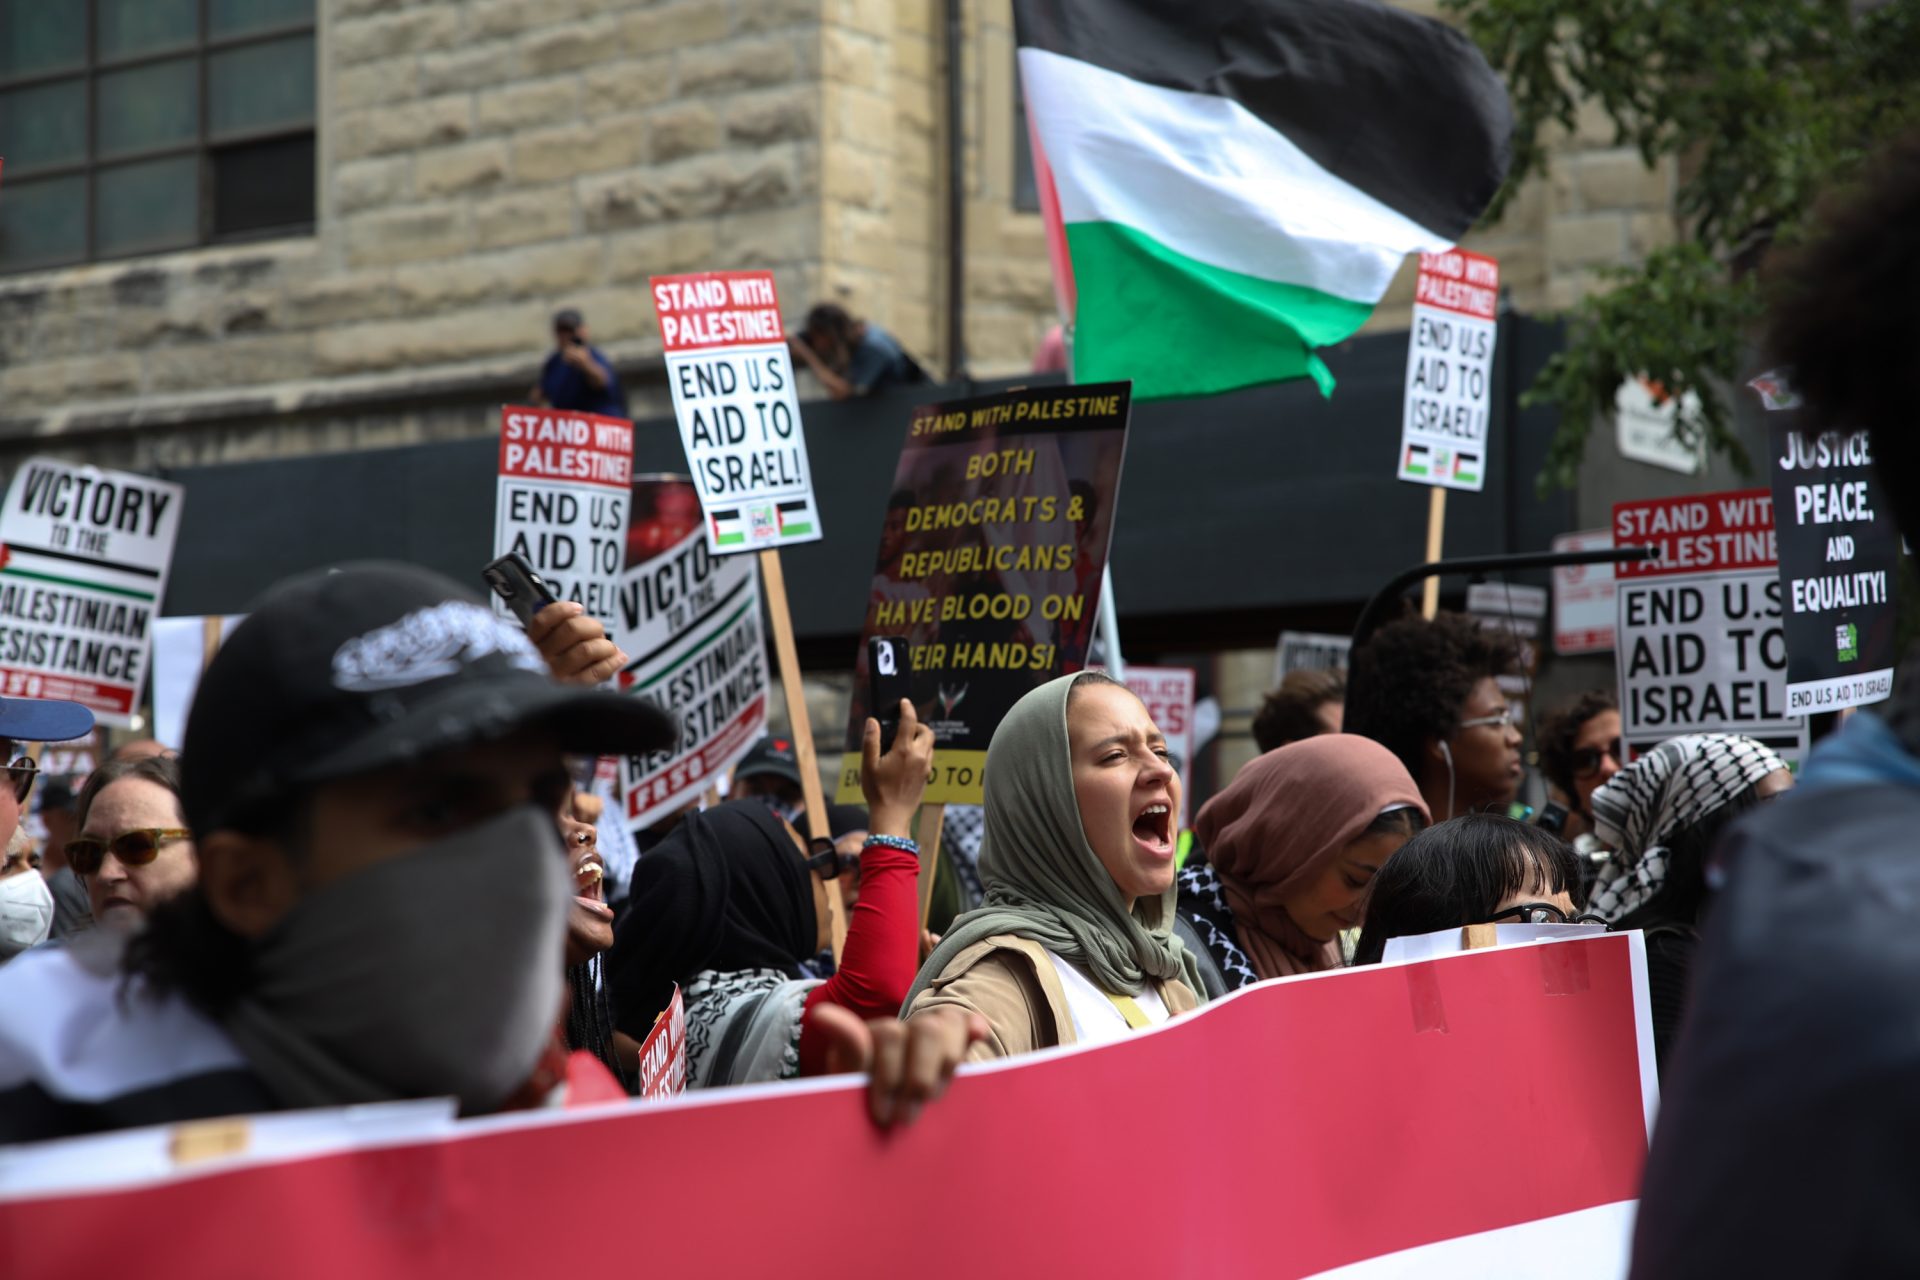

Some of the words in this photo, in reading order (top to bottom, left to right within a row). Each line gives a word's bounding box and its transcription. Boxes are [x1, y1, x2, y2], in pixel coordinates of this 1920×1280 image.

[655, 280, 727, 311] STAND
[729, 278, 774, 306] WITH
[662, 310, 780, 346] PALESTINE!
[1418, 317, 1452, 351] END
[679, 362, 737, 399] END
[745, 358, 783, 393] U.S
[1412, 357, 1448, 394] AID
[1459, 365, 1484, 400] TO
[507, 414, 589, 445] STAND
[595, 423, 631, 451] WITH
[692, 405, 746, 449] AID
[754, 400, 792, 442] TO
[912, 412, 966, 436] STAND
[971, 405, 1011, 428] WITH
[1015, 396, 1119, 421] PALESTINE
[1410, 397, 1483, 441] ISRAEL!
[505, 444, 631, 484] PALESTINE!
[698, 448, 802, 495] ISRAEL!
[966, 449, 1035, 480] BOTH
[20, 465, 170, 539] VICTORY
[510, 489, 577, 525] END
[589, 497, 622, 531] U.S
[905, 496, 1055, 532] DEMOCRATS
[1066, 495, 1084, 521] &
[1617, 503, 1709, 537] STAND
[1718, 496, 1775, 528] WIT
[1794, 481, 1875, 525] PEACE,
[511, 530, 576, 570] AID
[590, 538, 618, 576] TO
[899, 545, 1073, 578] REPUBLICANS
[1825, 536, 1855, 562] AND
[620, 535, 729, 631] VICTO
[1626, 586, 1704, 627] END
[1722, 580, 1783, 620] U.S
[1791, 570, 1887, 613] EQUALITY!
[0, 583, 148, 640] ALESTINIAN
[876, 599, 935, 626] HAVE
[941, 593, 1030, 621] BLOOD
[1041, 595, 1084, 620] ON
[0, 627, 140, 682] ESISTANCE
[909, 644, 946, 671] EIR
[1628, 633, 1706, 678] AID
[1727, 628, 1787, 672] TO
[1631, 681, 1791, 727] ISRAEL
[1792, 690, 1812, 708] END
[1836, 684, 1851, 701] AID
[1853, 682, 1863, 697] TO
[946, 767, 973, 786] TO
[642, 1028, 668, 1097] STAND
